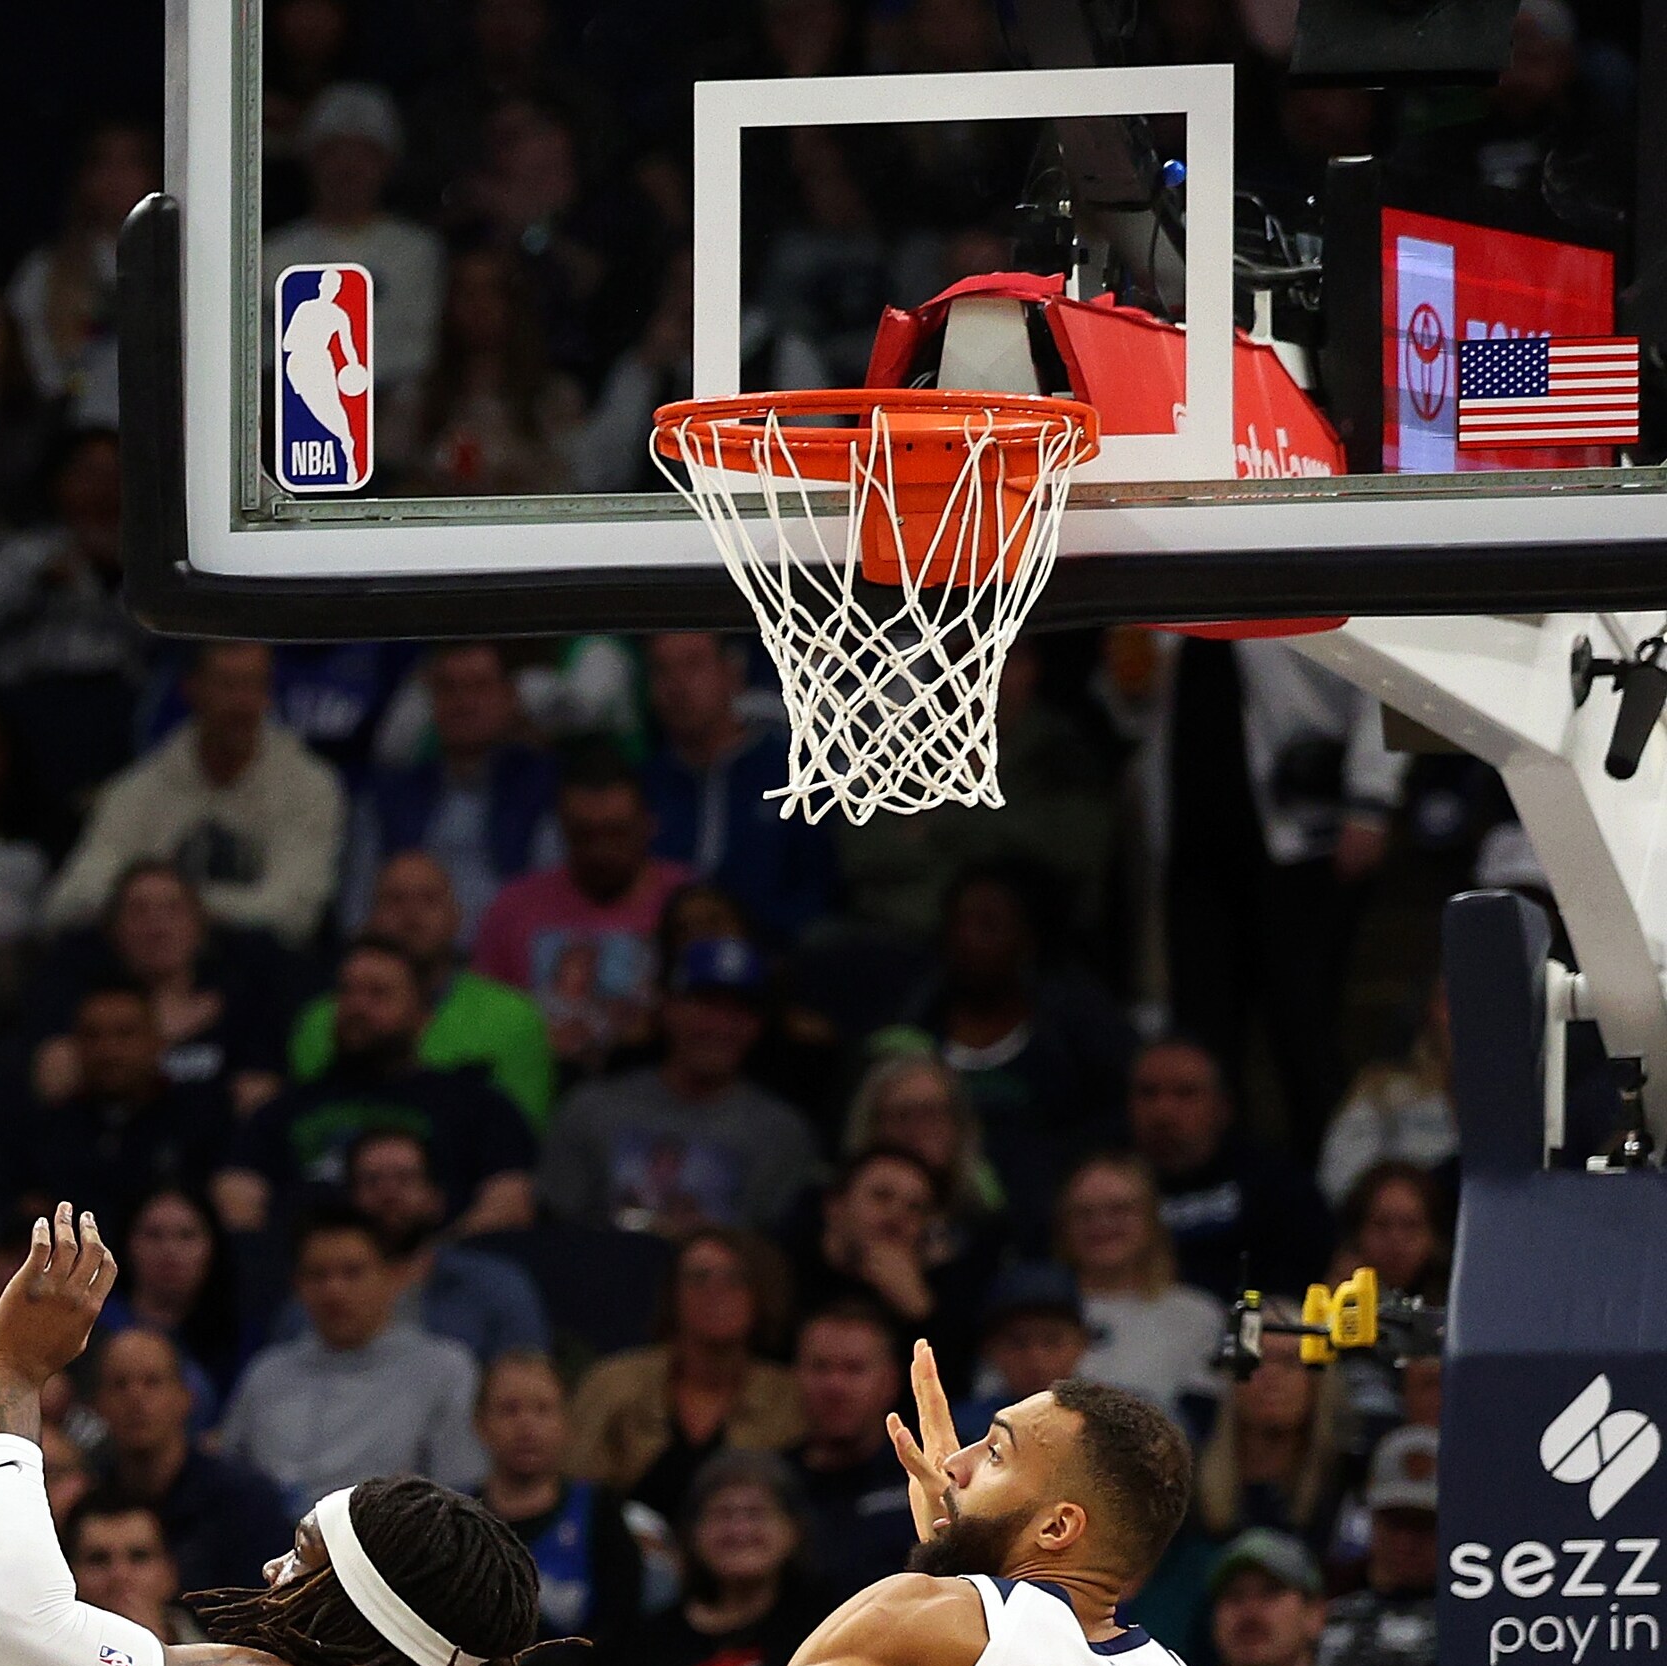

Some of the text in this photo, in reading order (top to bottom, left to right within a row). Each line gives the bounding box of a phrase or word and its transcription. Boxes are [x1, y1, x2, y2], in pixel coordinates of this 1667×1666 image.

[291, 440, 337, 476] NBA
[1489, 1602, 1660, 1666] pay in
